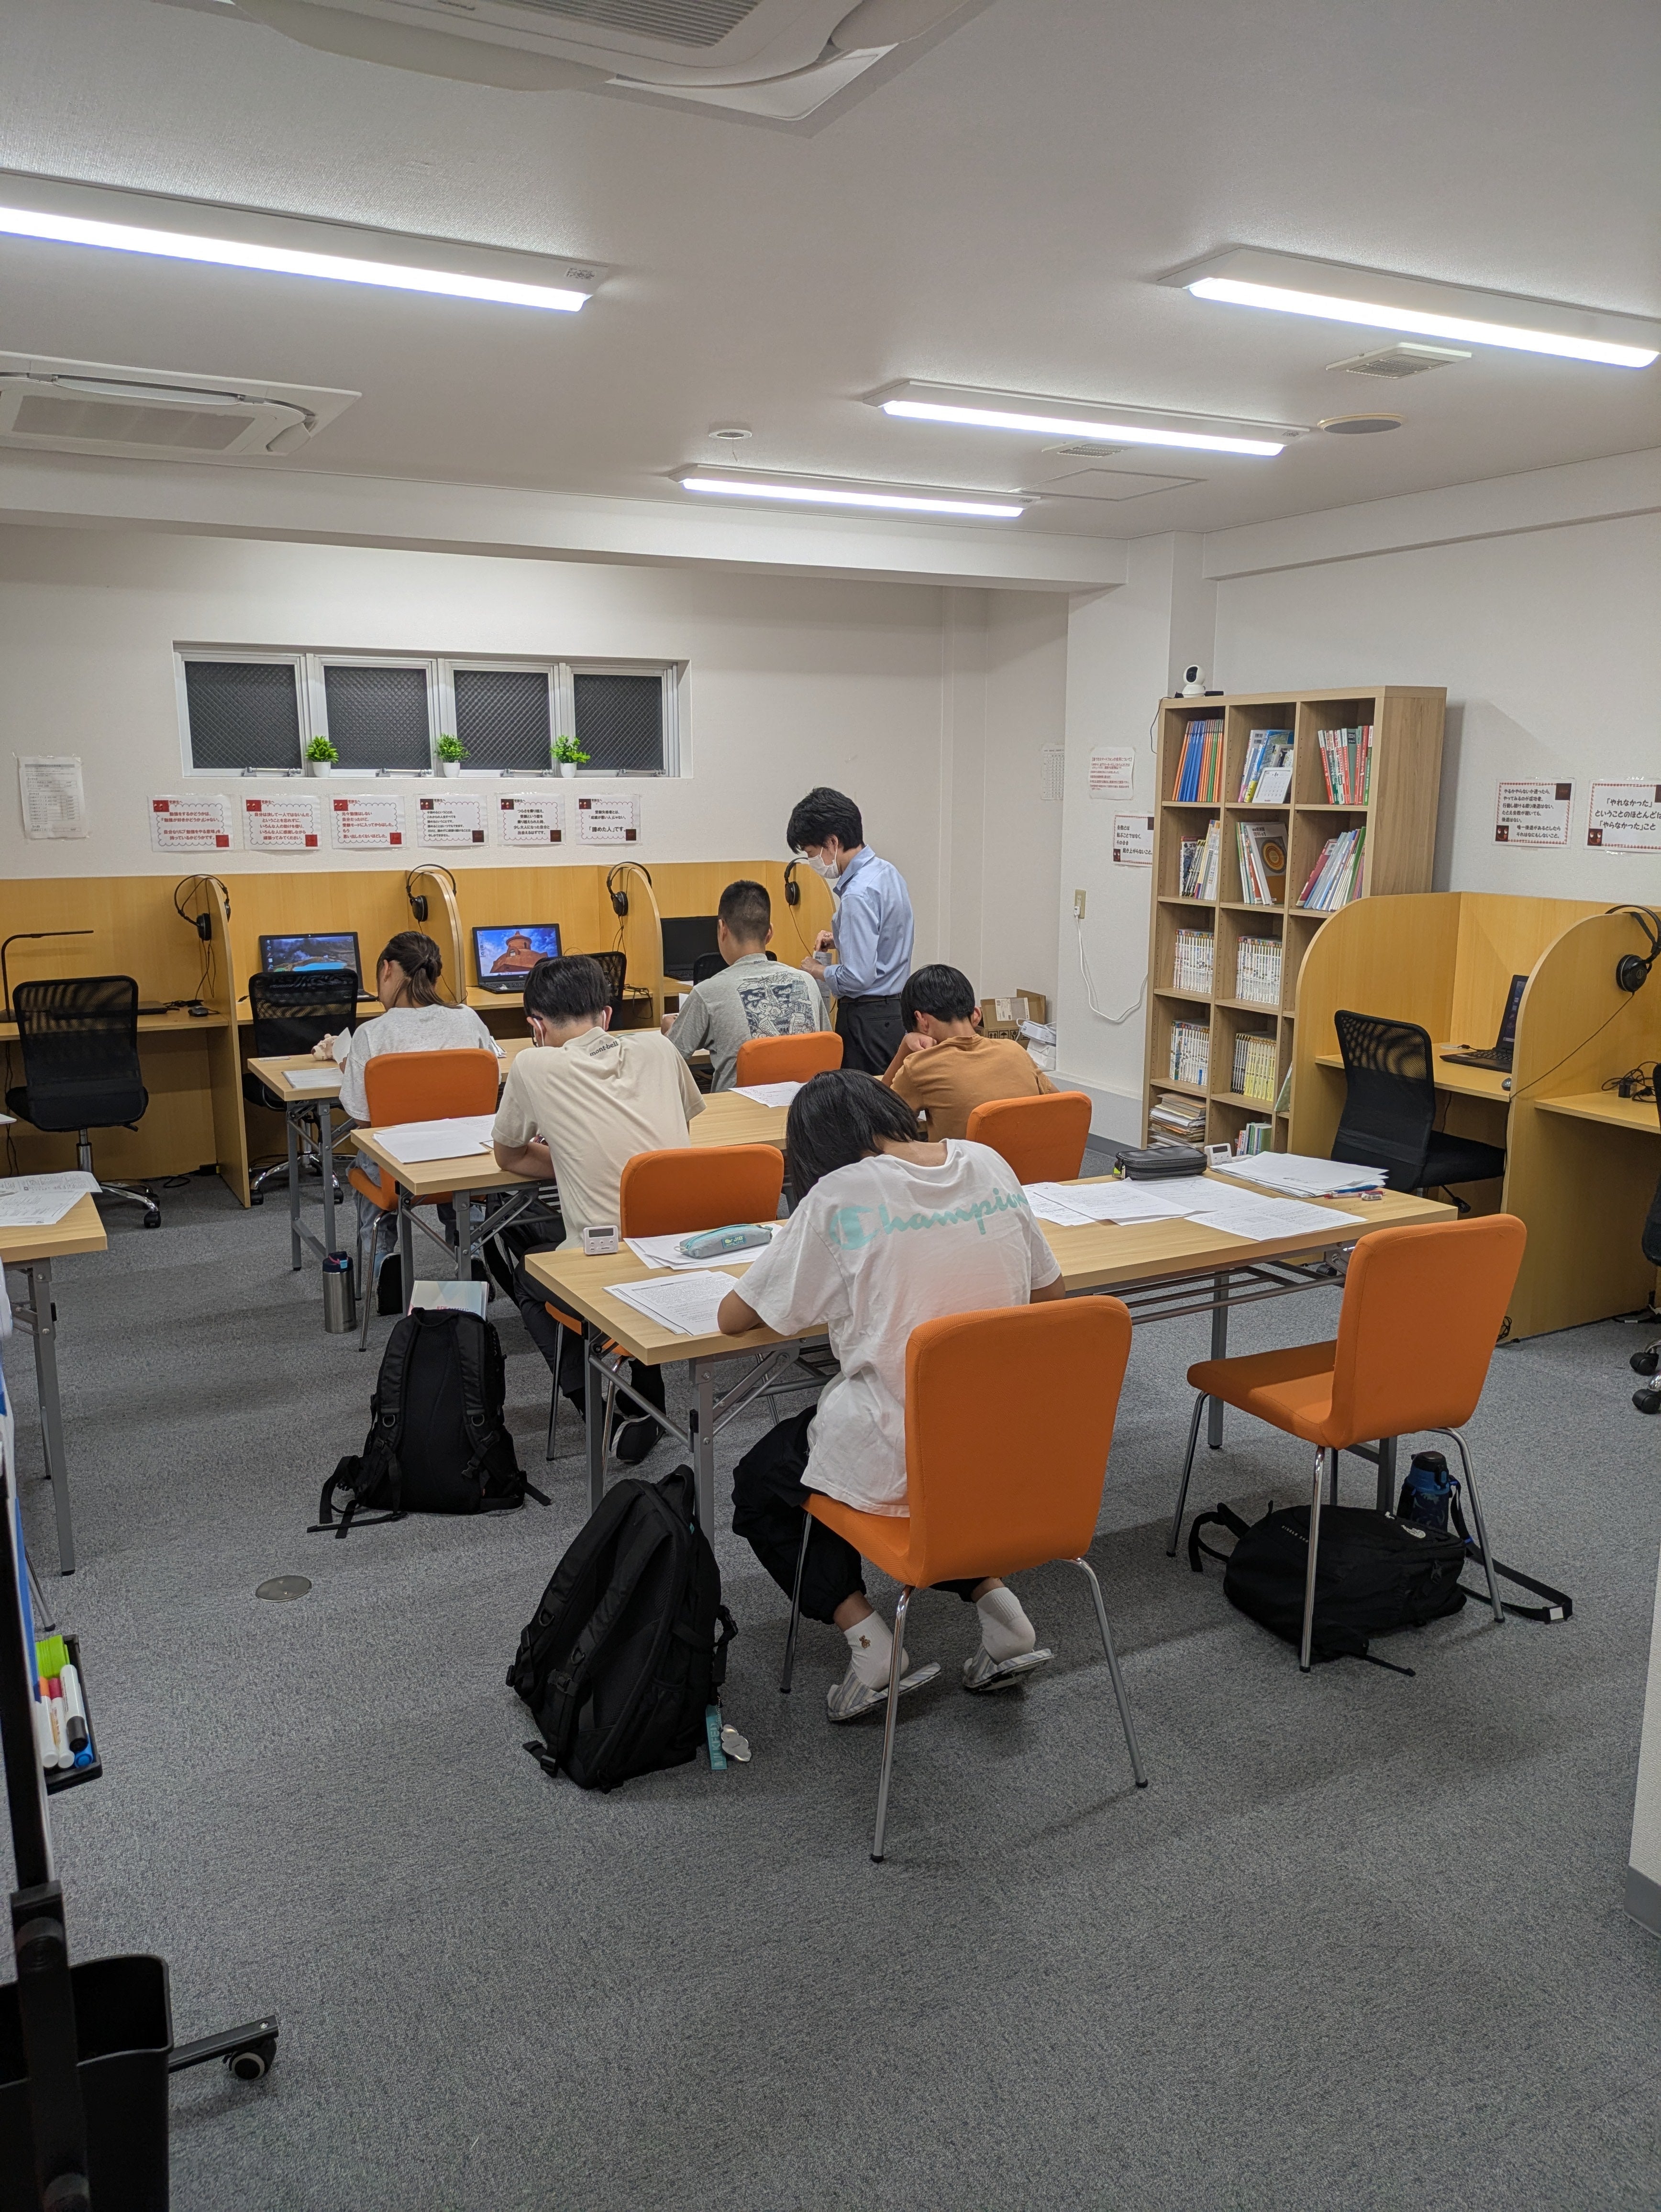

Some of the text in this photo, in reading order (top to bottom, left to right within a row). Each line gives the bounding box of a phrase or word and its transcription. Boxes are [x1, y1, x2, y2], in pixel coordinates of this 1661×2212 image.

[1607, 798, 1652, 807] 「やれなかった」
[1600, 821, 1656, 830] 「やらなかった」こと
[829, 1188, 1029, 1250] Champion
